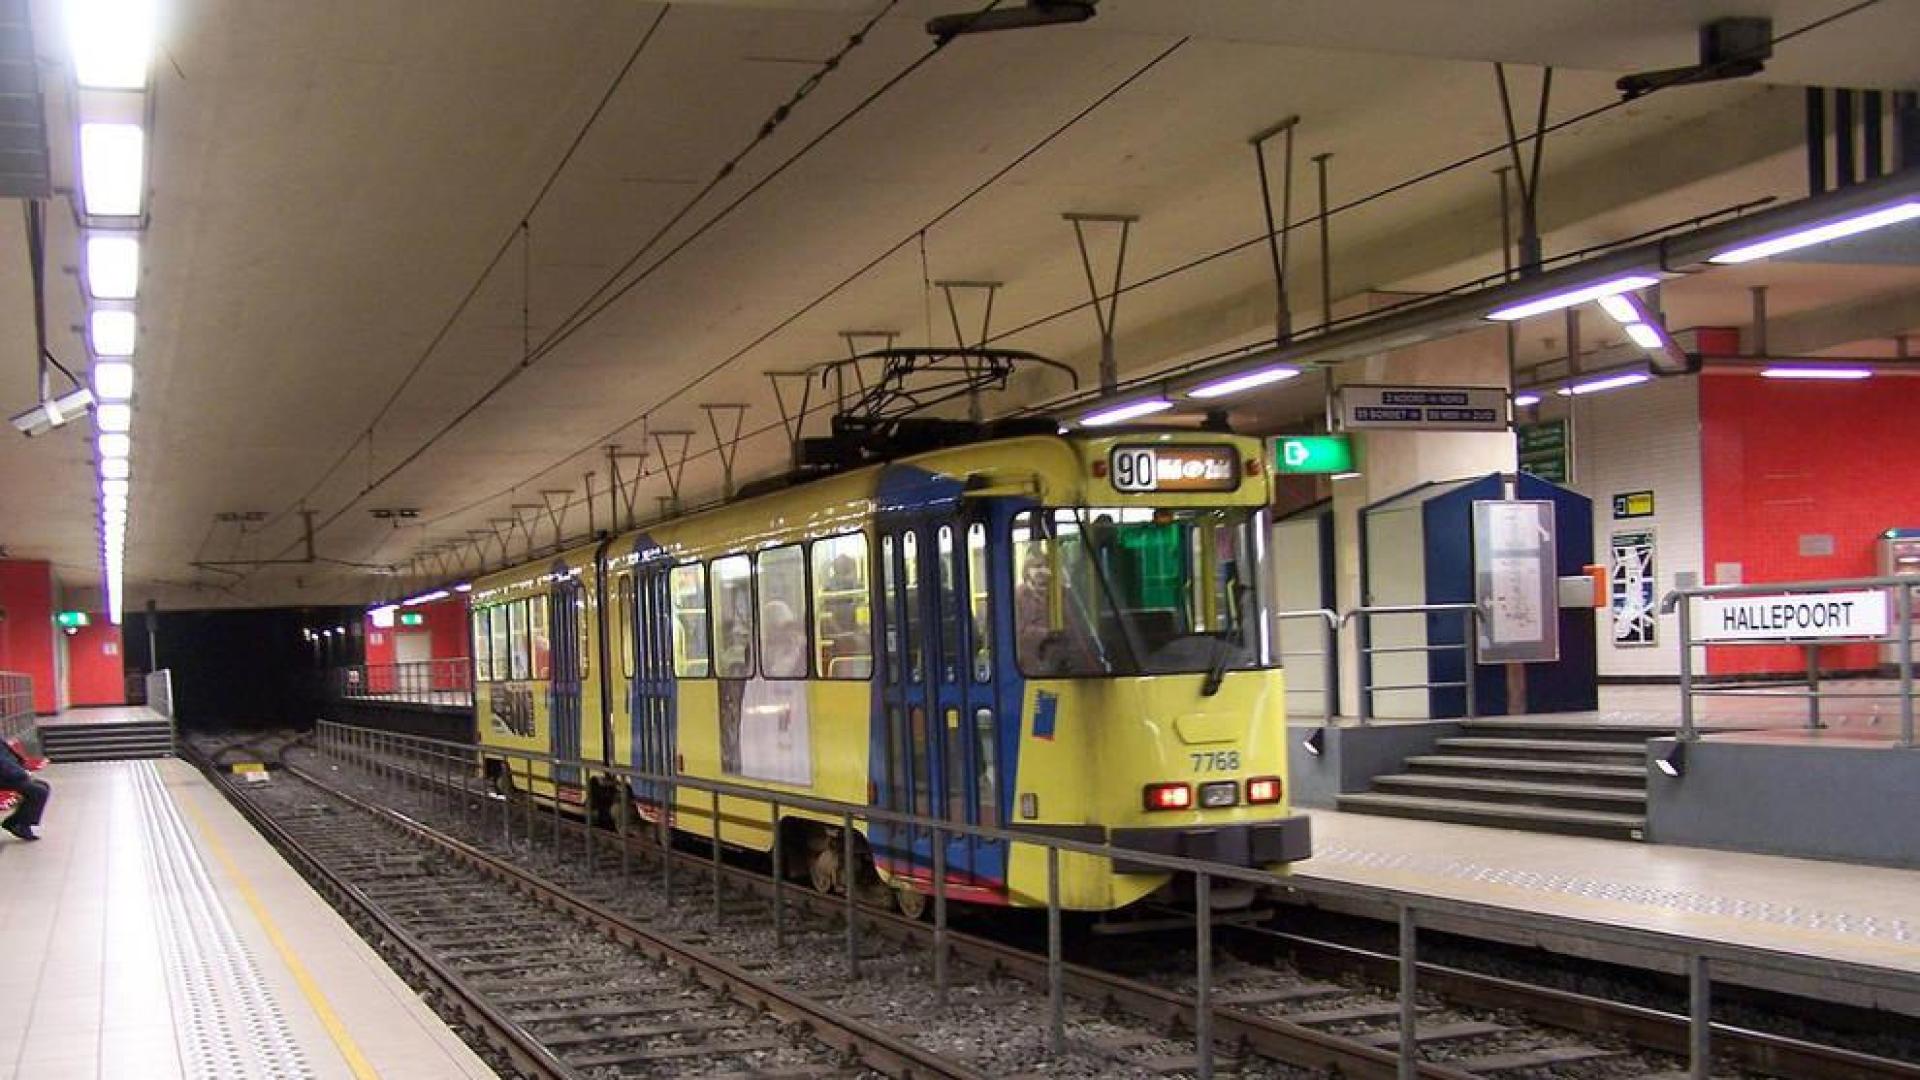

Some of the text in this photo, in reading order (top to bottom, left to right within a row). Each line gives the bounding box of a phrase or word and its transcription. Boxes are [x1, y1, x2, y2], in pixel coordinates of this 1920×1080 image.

[1118, 452, 1152, 487] 90
[1723, 601, 1854, 630] HALLEPOORT
[1190, 751, 1240, 773] 7768
